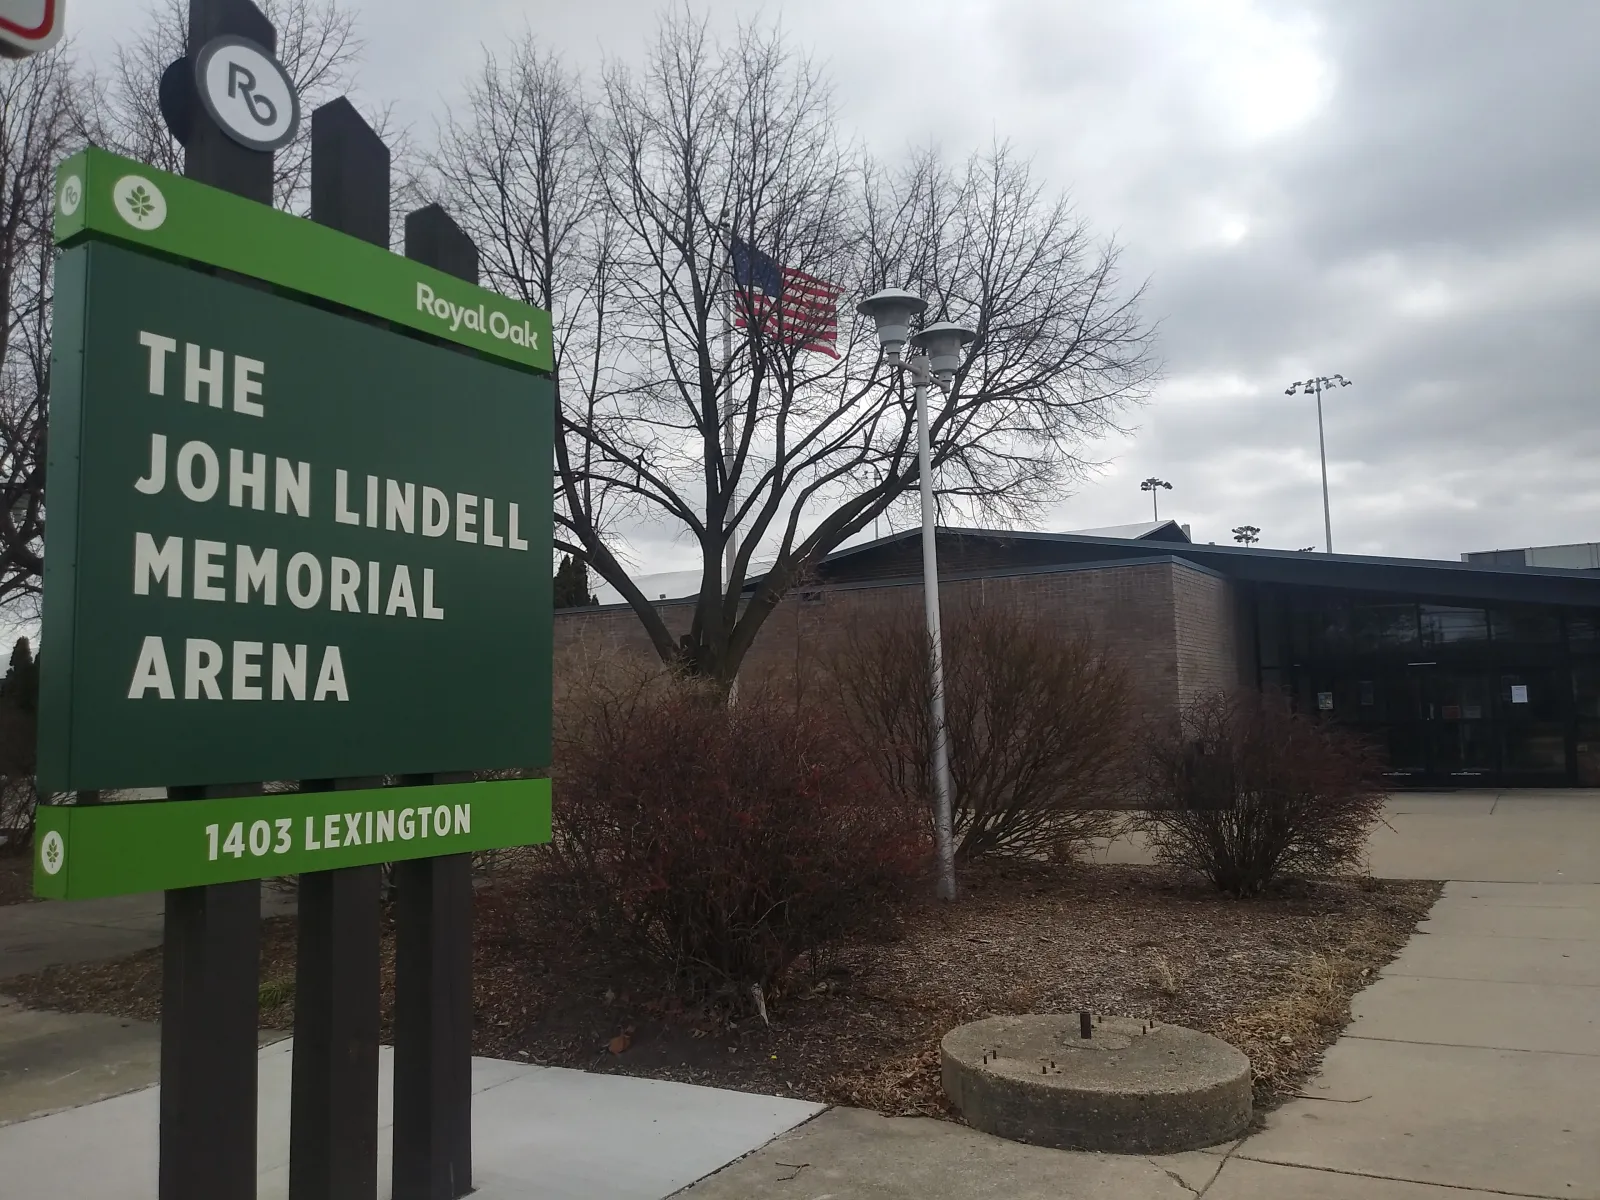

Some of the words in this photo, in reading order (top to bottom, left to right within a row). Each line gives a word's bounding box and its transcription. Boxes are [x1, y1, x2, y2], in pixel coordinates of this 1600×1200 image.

[416, 282, 486, 334] Royal
[489, 312, 538, 350] Oak
[139, 331, 265, 418] THE
[135, 433, 311, 518] JOHN
[335, 469, 529, 551] LINDELL
[133, 532, 444, 620] MEMORIAL
[127, 635, 350, 701] ARENA
[205, 817, 292, 861] 1403
[305, 803, 471, 850] LEXINGTON
